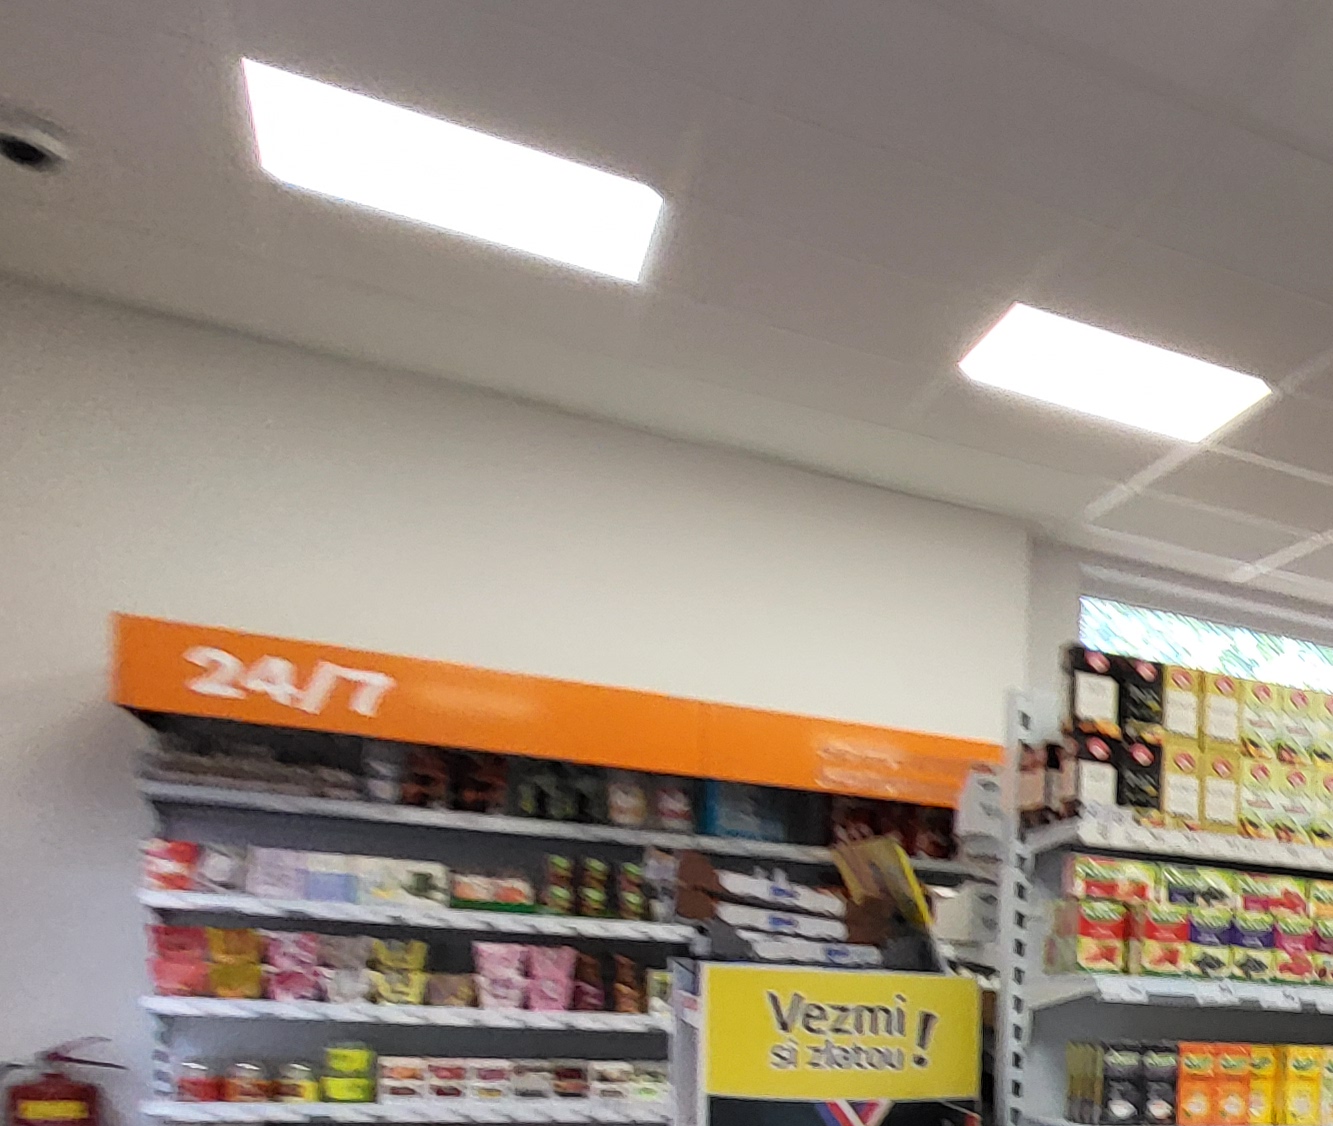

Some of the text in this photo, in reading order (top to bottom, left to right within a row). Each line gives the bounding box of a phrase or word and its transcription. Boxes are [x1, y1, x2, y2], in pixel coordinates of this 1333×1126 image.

[183, 645, 396, 718] 24/7
[767, 990, 907, 1037] Vezmi
[770, 1038, 798, 1070] si
